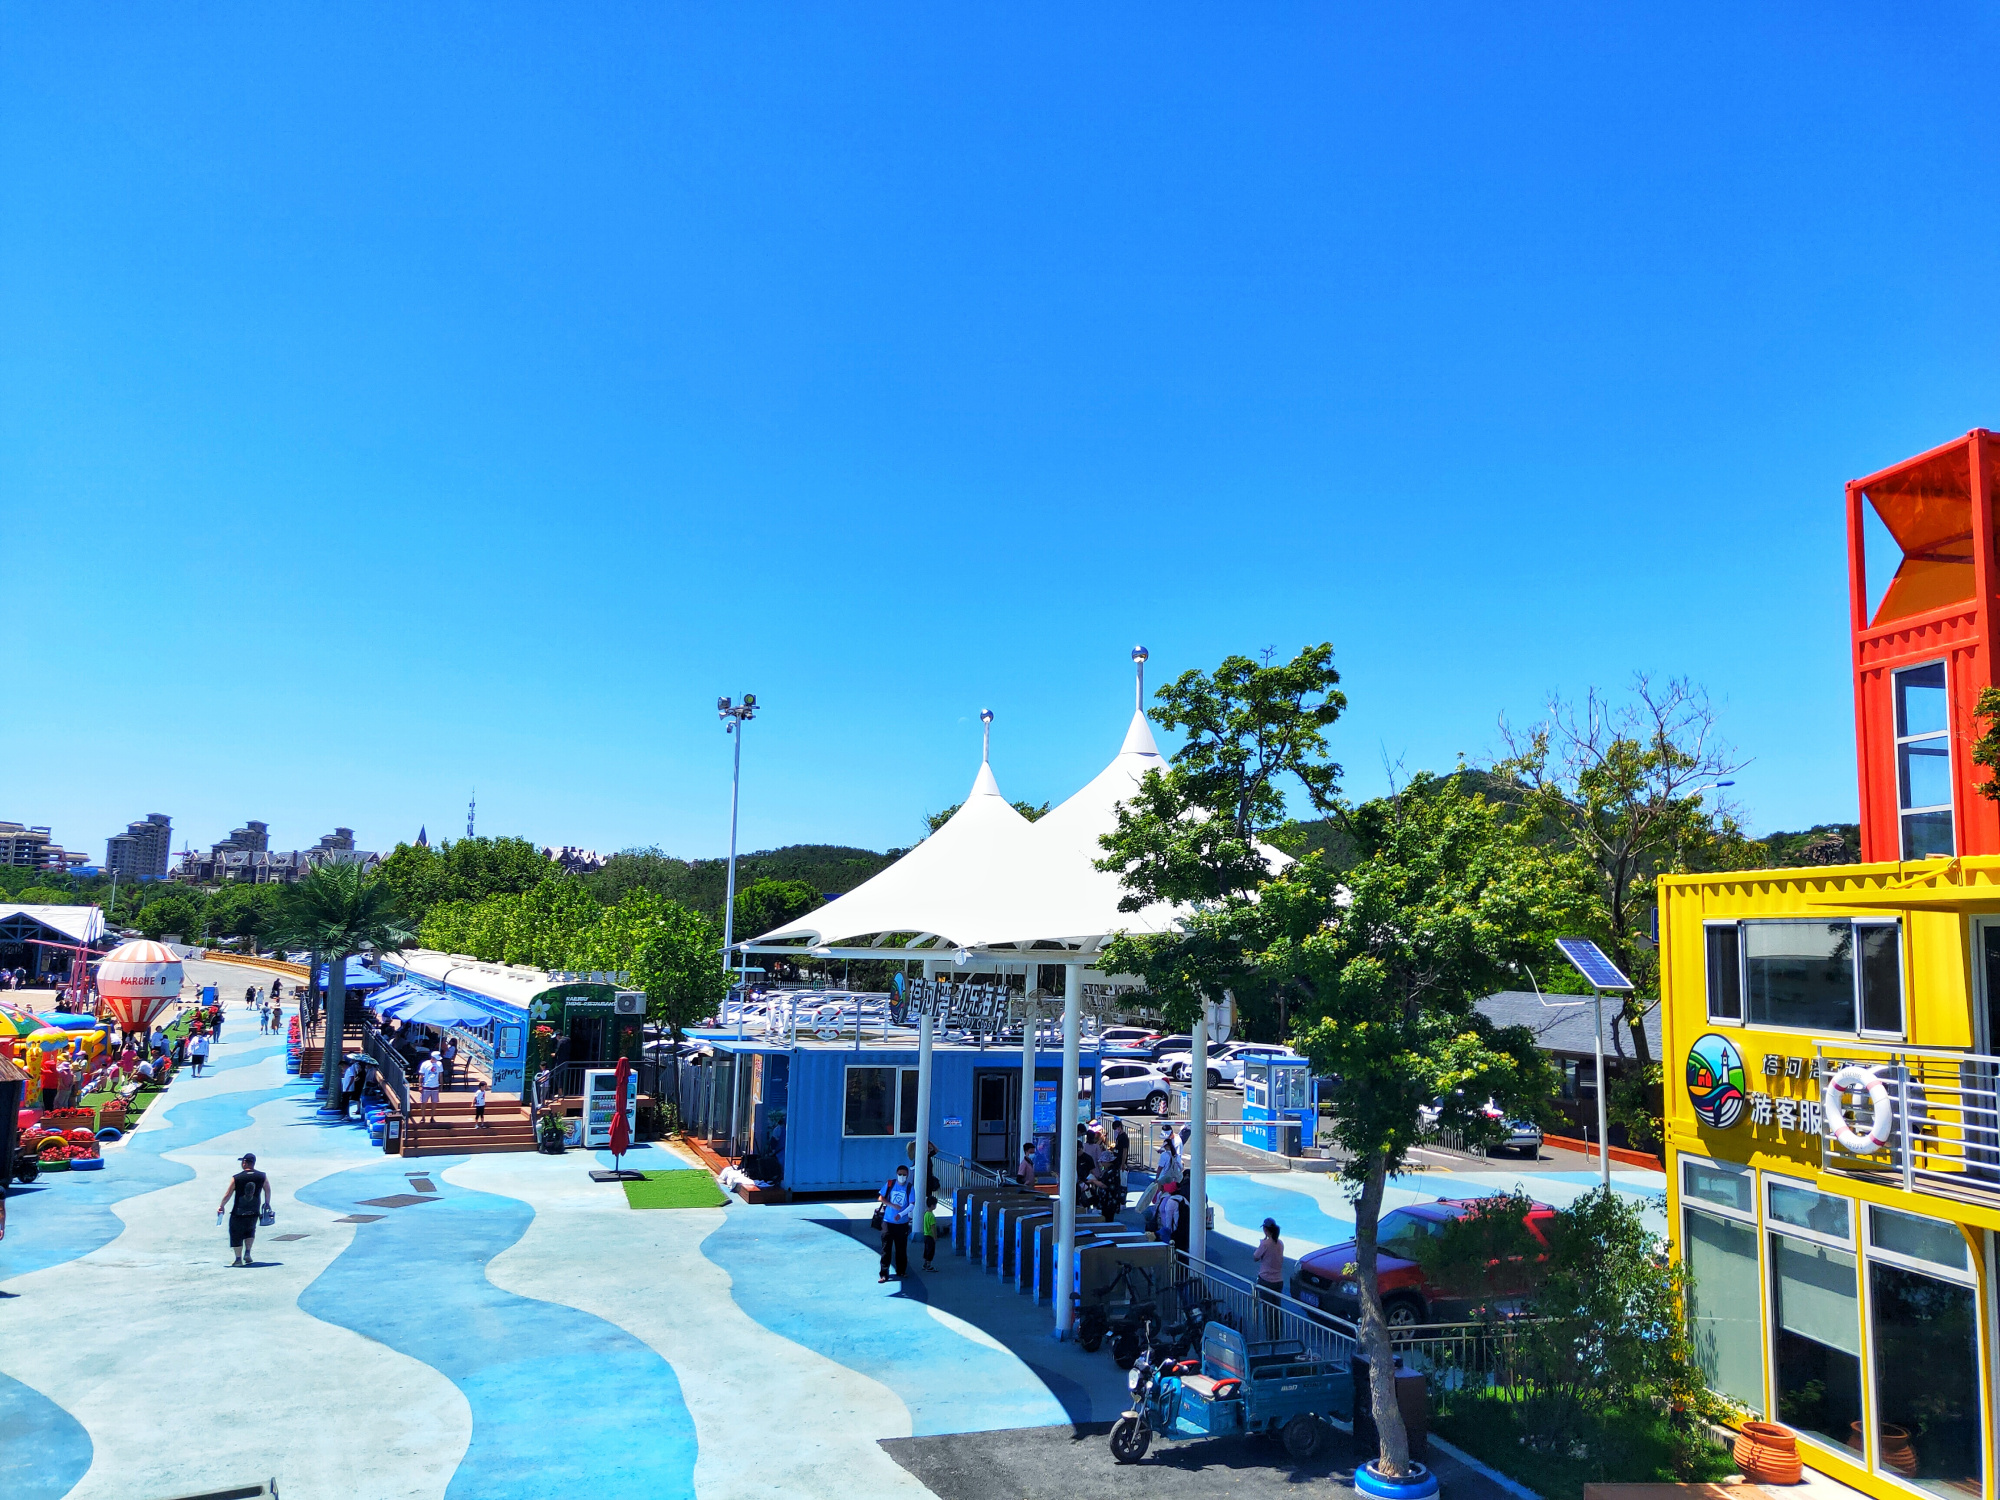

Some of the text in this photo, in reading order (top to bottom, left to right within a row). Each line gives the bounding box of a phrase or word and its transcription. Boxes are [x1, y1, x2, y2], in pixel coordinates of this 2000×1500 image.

[121, 976, 155, 985] MARCHE
[908, 977, 1008, 1033] 塔河湾欢乐海岸
